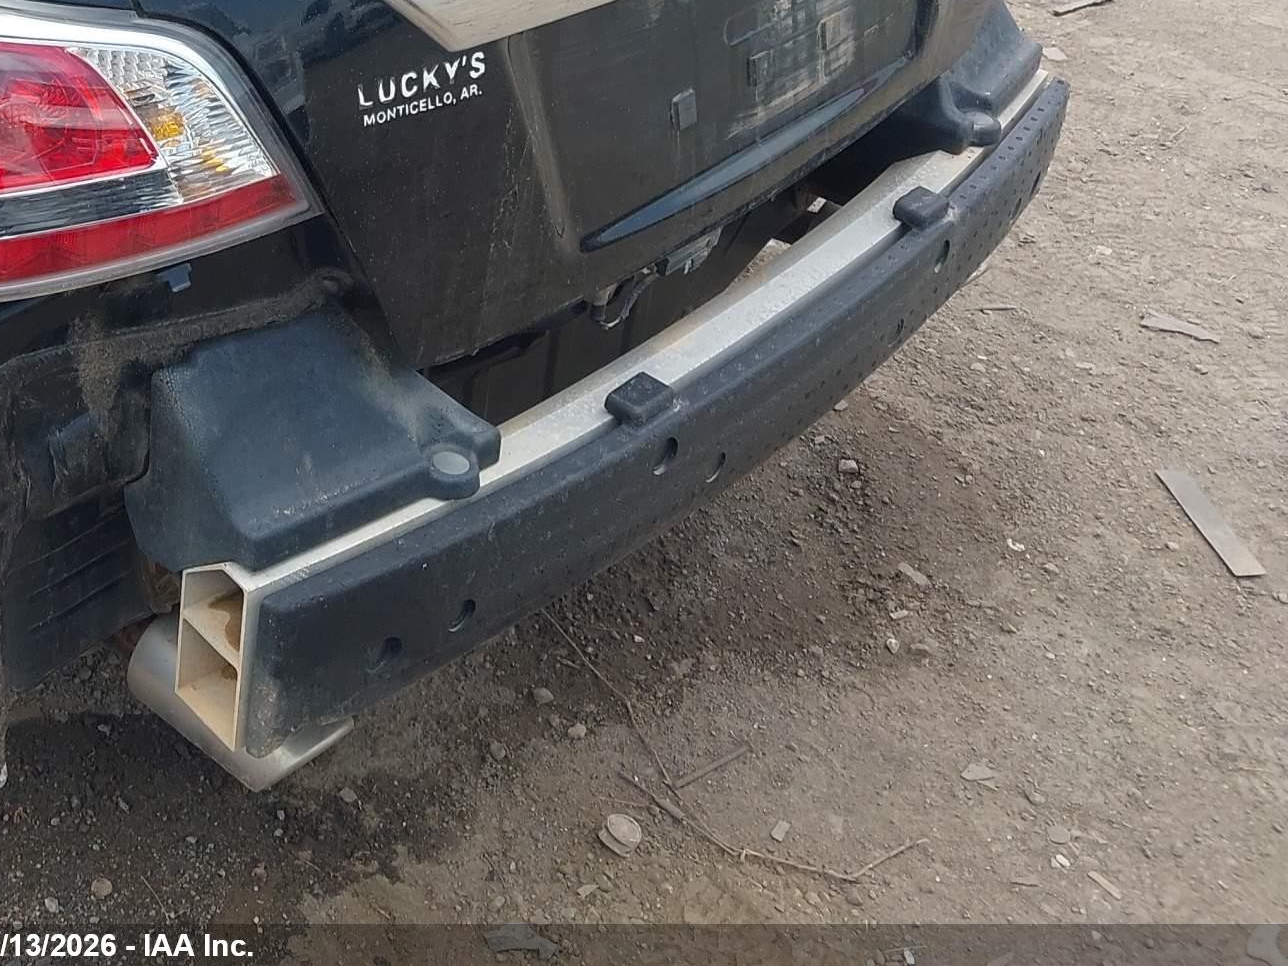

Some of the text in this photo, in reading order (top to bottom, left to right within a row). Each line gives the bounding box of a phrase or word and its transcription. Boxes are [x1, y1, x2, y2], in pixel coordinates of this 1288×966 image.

[357, 51, 485, 110] LUCKY'S
[363, 83, 482, 127] MONTICELLO, AR.
